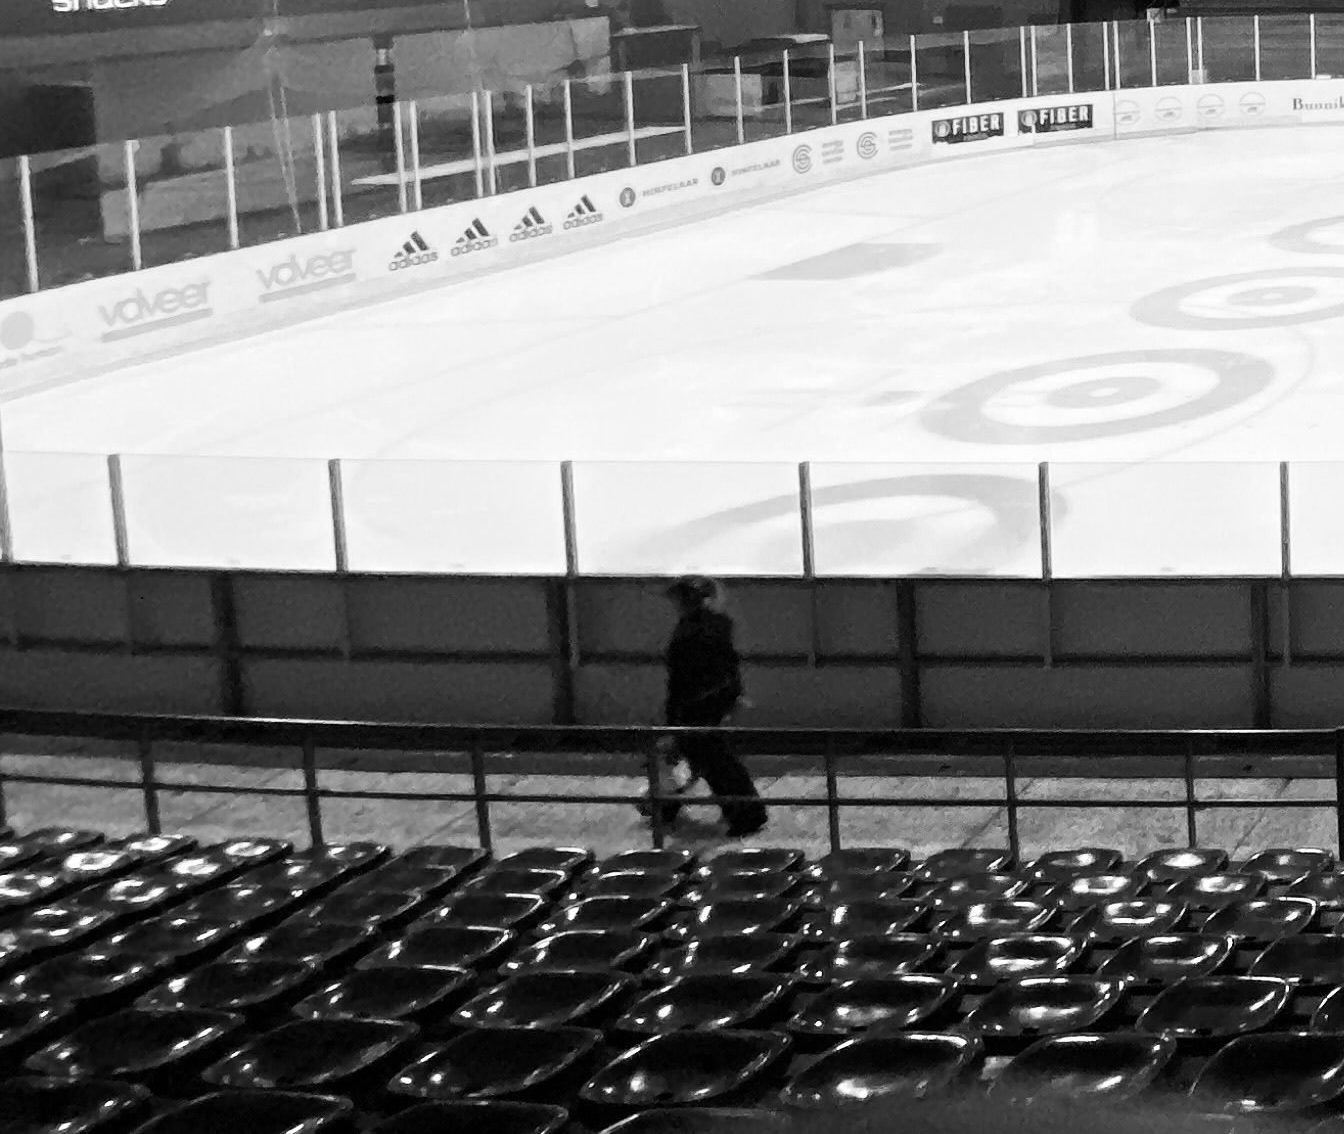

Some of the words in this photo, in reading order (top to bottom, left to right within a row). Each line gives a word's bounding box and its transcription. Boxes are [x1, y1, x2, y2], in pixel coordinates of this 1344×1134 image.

[952, 115, 1000, 135] FIBER
[1039, 106, 1089, 125] FIBER
[388, 251, 438, 271] adidas
